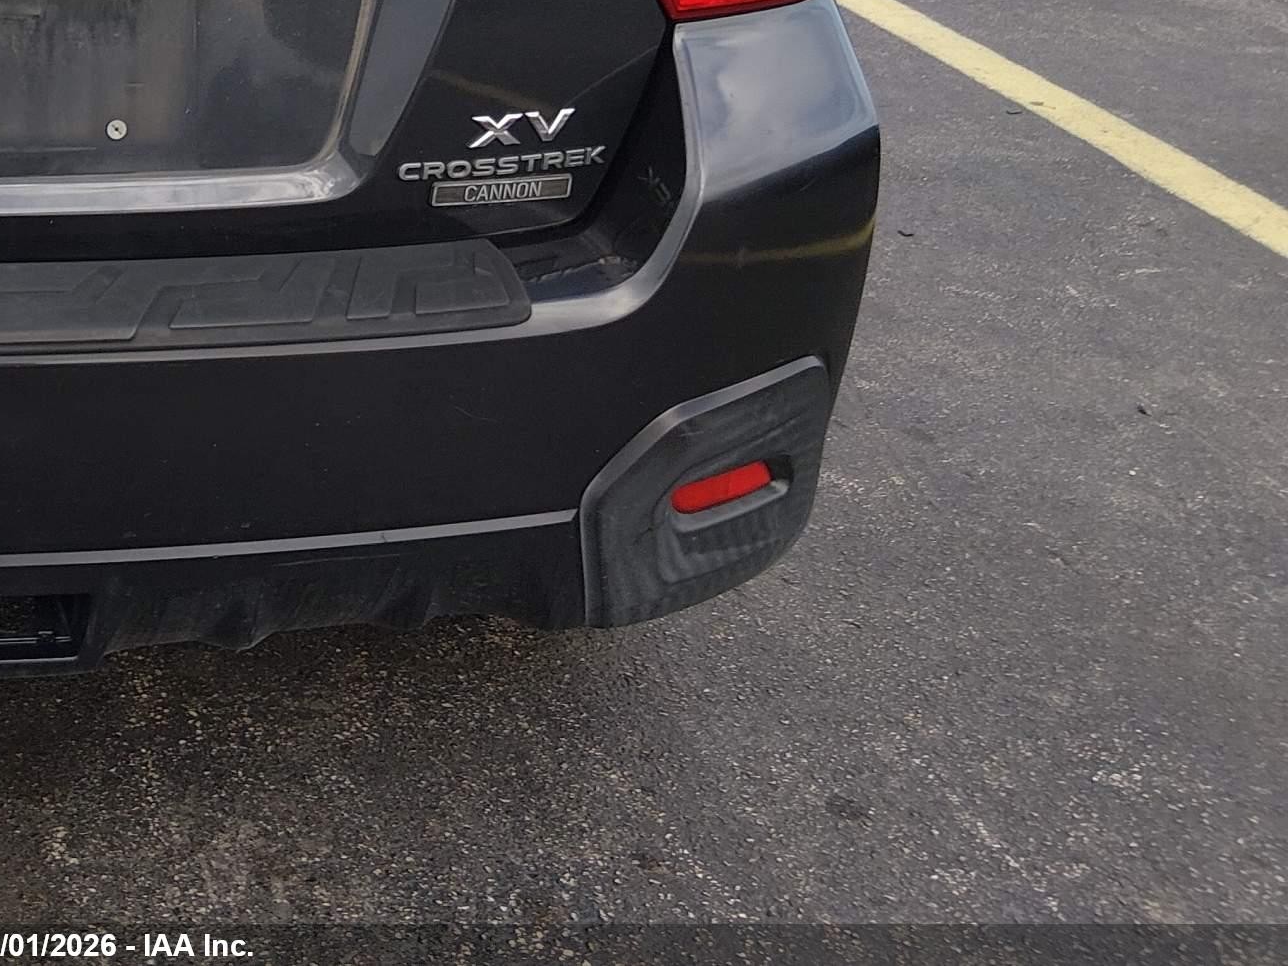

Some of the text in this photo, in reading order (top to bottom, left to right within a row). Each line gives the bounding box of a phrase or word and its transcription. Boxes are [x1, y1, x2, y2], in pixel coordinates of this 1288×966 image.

[468, 107, 576, 149] XV
[398, 145, 607, 182] CROSSTREK
[464, 181, 542, 203] CANNON
